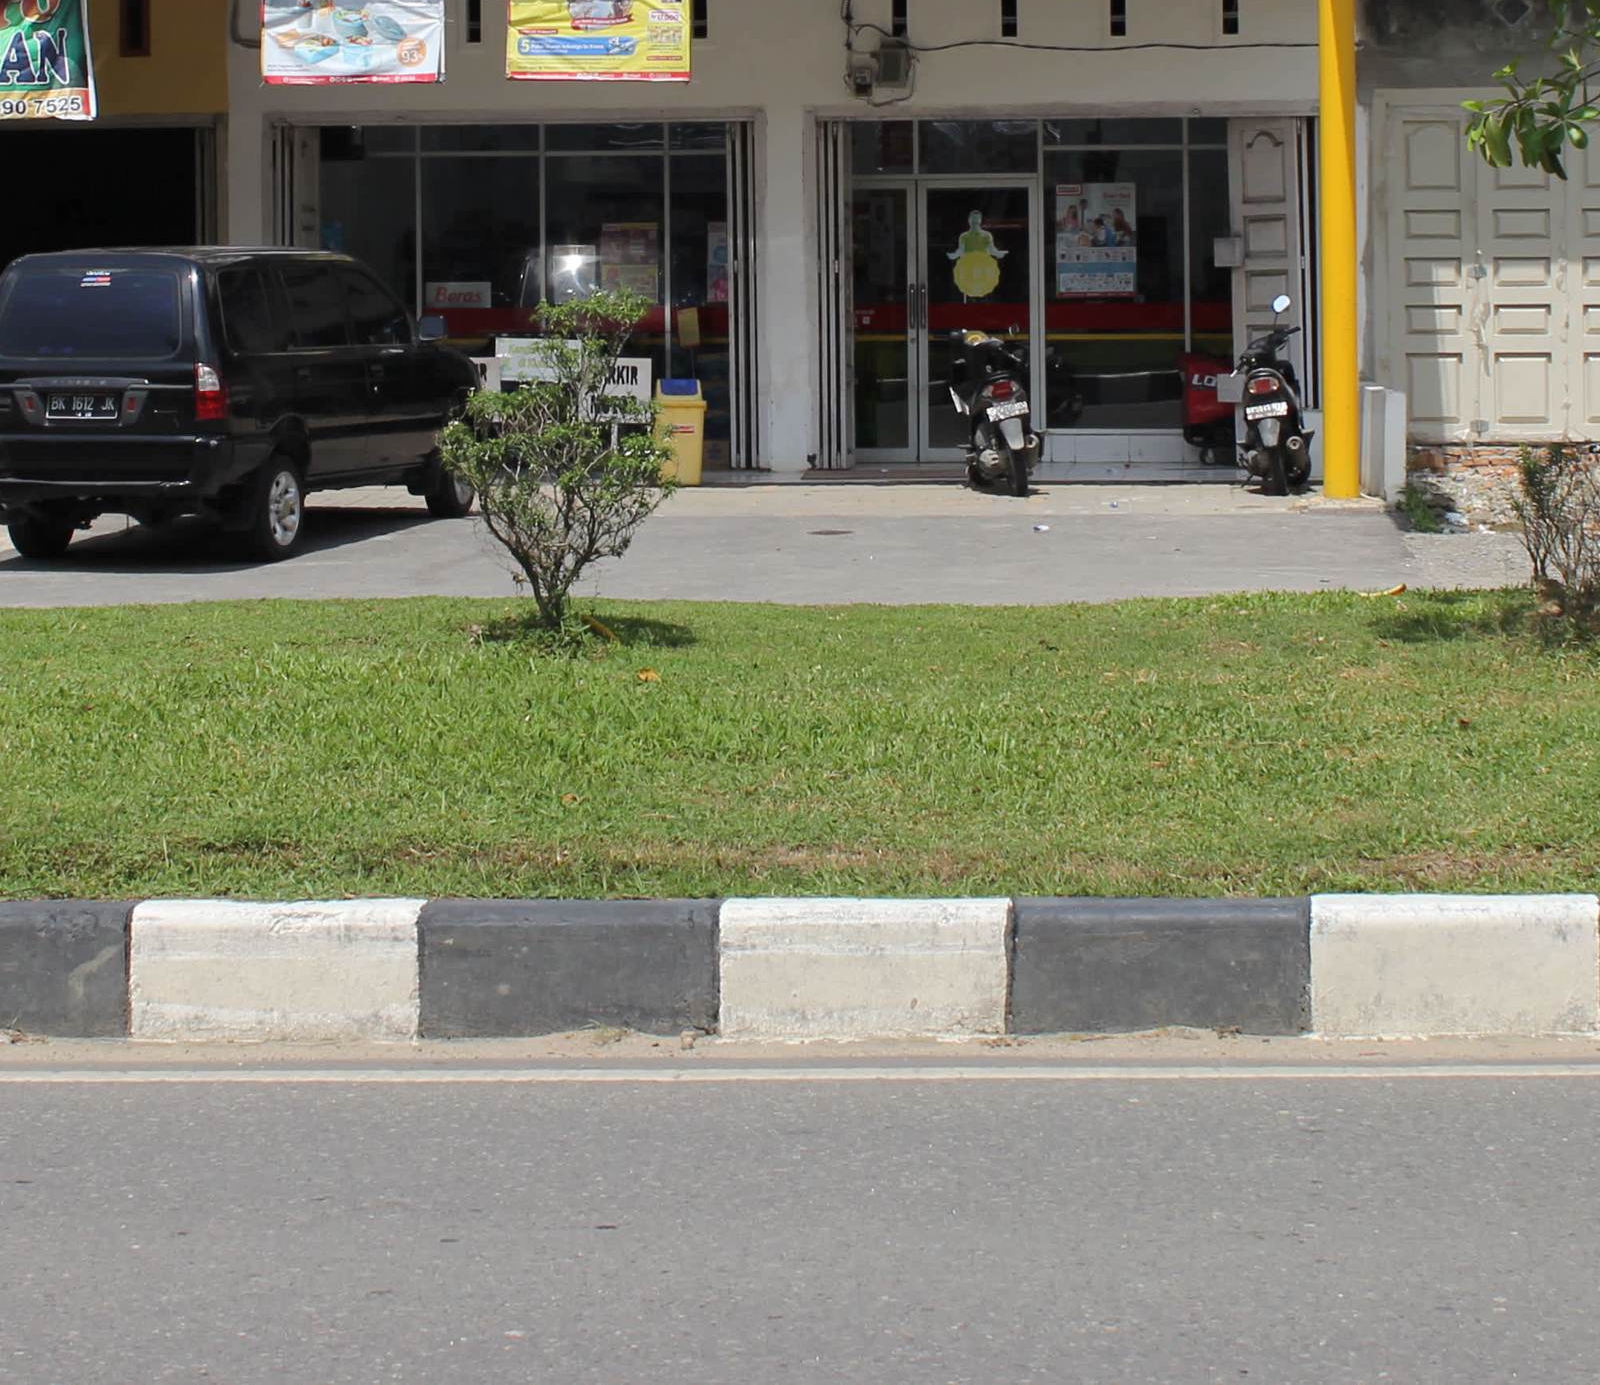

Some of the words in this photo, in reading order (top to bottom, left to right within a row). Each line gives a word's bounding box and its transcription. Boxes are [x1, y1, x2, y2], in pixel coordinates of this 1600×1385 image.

[0, 30, 69, 84] AN
[2, 100, 26, 115] 90
[34, 96, 81, 114] 7525
[51, 396, 66, 411] BK
[72, 395, 95, 411] 1612
[101, 396, 115, 411] JK
